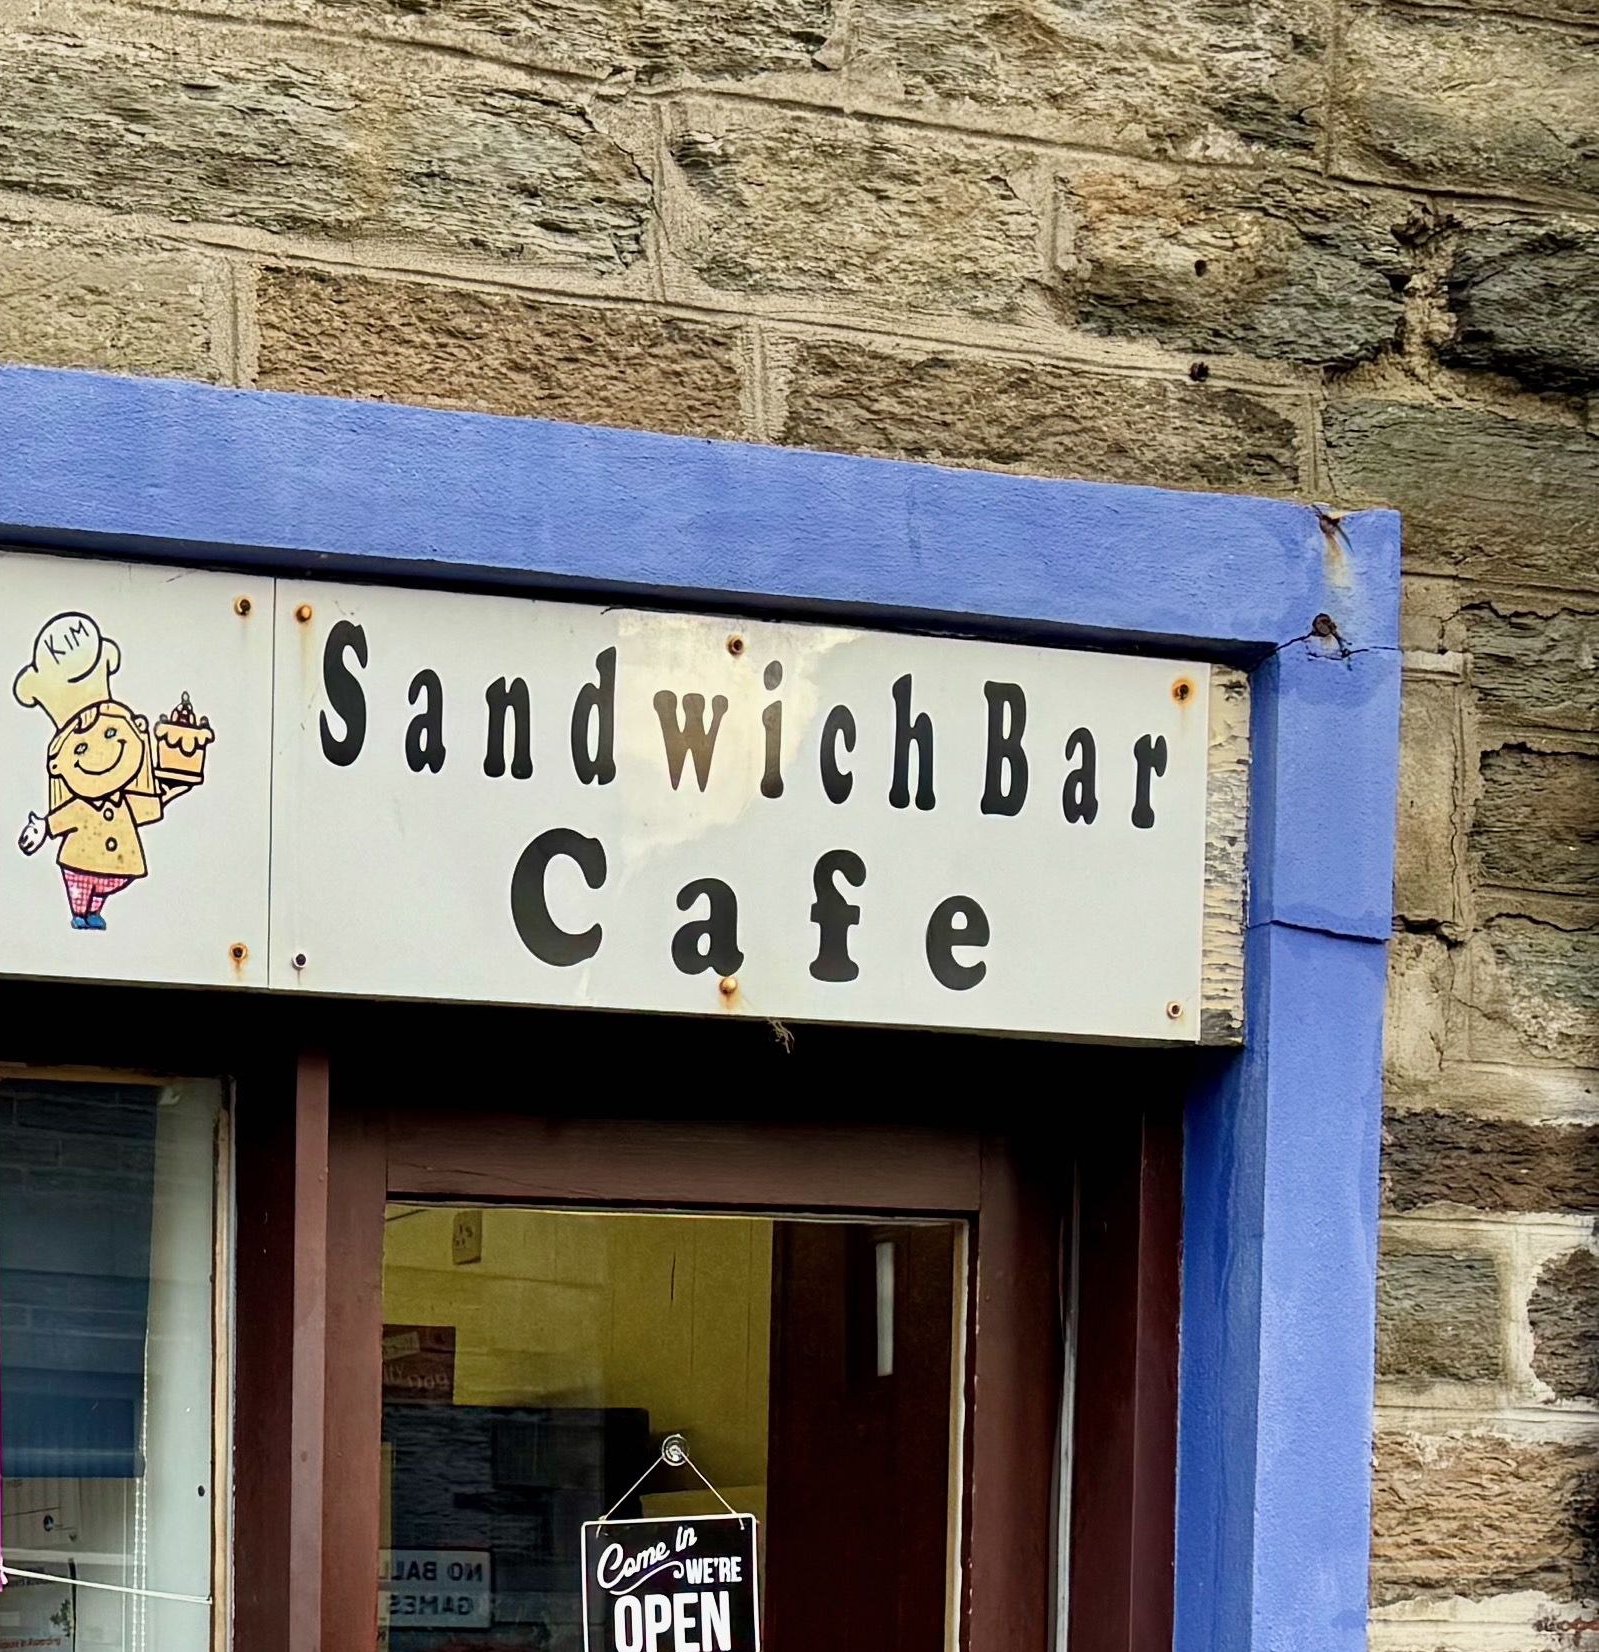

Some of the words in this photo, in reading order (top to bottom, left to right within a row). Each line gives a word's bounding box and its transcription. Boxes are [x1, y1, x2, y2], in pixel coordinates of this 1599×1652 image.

[44, 620, 89, 664] KIM
[510, 827, 990, 992] Cafe
[597, 1542, 671, 1589] Come
[685, 1556, 743, 1585] WE'RE
